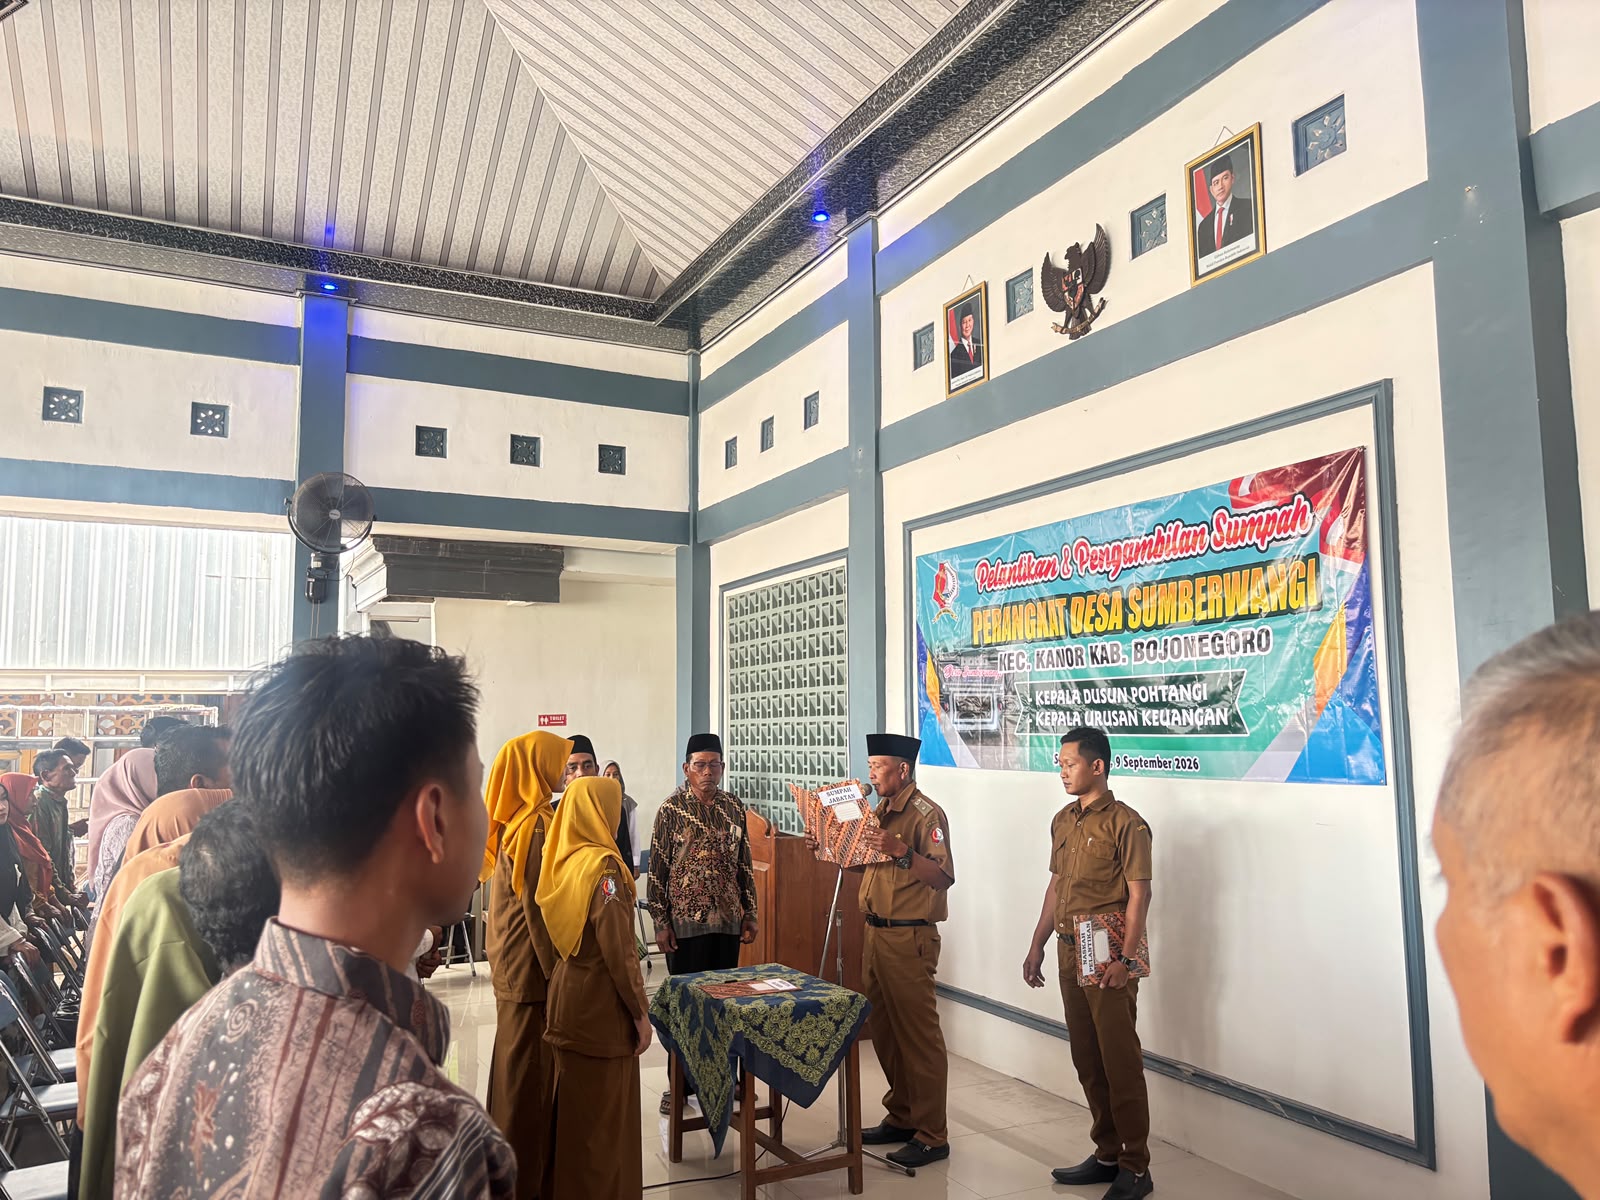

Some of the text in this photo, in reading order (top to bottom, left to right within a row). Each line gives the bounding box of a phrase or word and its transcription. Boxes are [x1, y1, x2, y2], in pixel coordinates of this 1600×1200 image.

[975, 552, 1059, 592] Pelantikan
[1060, 545, 1072, 579] &
[1073, 523, 1208, 581] Pengambilan
[1210, 494, 1311, 551] Sumpah
[972, 558, 1318, 646] PERANGKAT DESA SUMBERWANGI
[999, 627, 1271, 672] KEC. KANOR KAB. BOJONEGORO
[1035, 689, 1081, 705] KEPALA
[1083, 687, 1128, 704] DUSUN
[1131, 683, 1208, 703] POHTANGI
[1035, 711, 1081, 726] KEPALA
[1084, 709, 1139, 727] URUSAN
[1141, 707, 1229, 727] KEUANGAN
[1115, 755, 1200, 771] 9 September 2026
[826, 786, 852, 797] SUMPAH
[828, 793, 856, 804] JABATAN
[1085, 922, 1095, 973] PELANTIKAN
